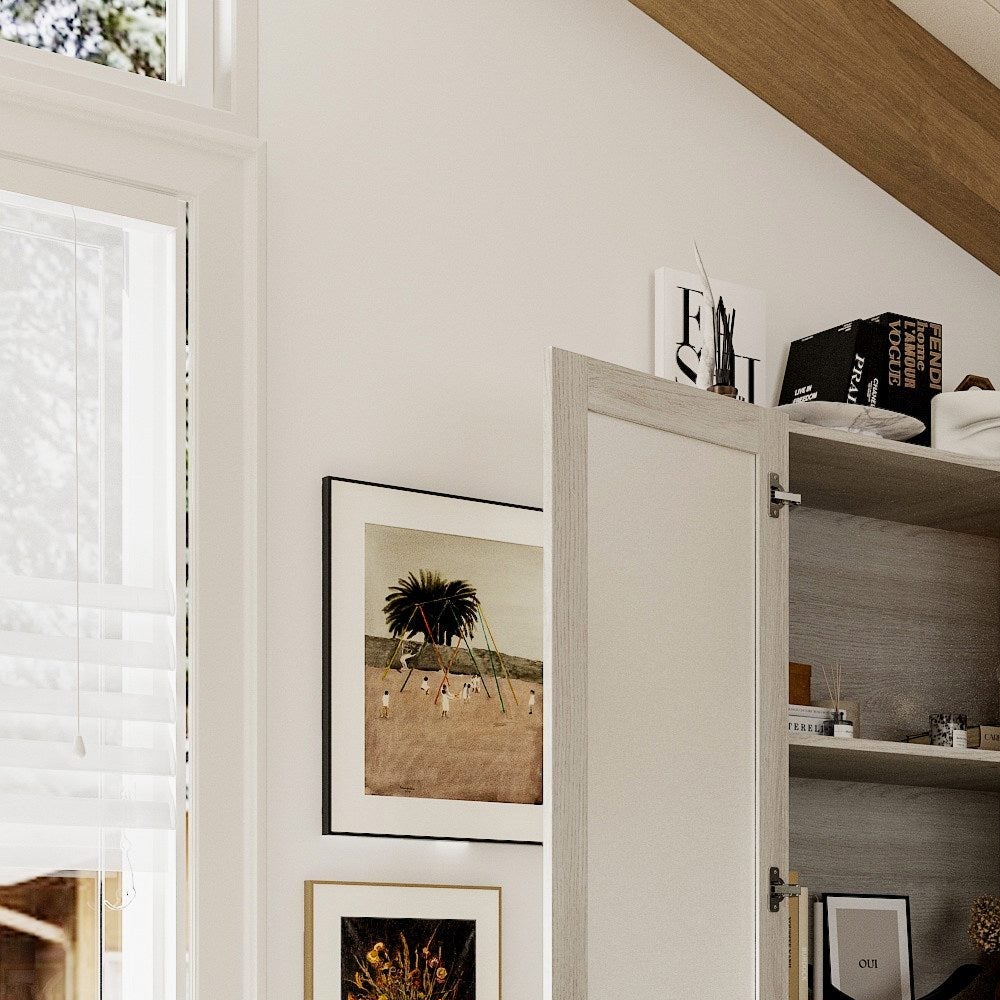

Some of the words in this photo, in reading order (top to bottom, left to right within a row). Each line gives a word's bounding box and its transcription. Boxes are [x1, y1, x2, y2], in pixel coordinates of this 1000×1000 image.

[889, 320, 902, 387] VOGUE
[904, 320, 916, 389] L'AMOUR
[917, 321, 929, 372] home
[929, 323, 943, 390] FENDI
[858, 958, 878, 969] OUI
